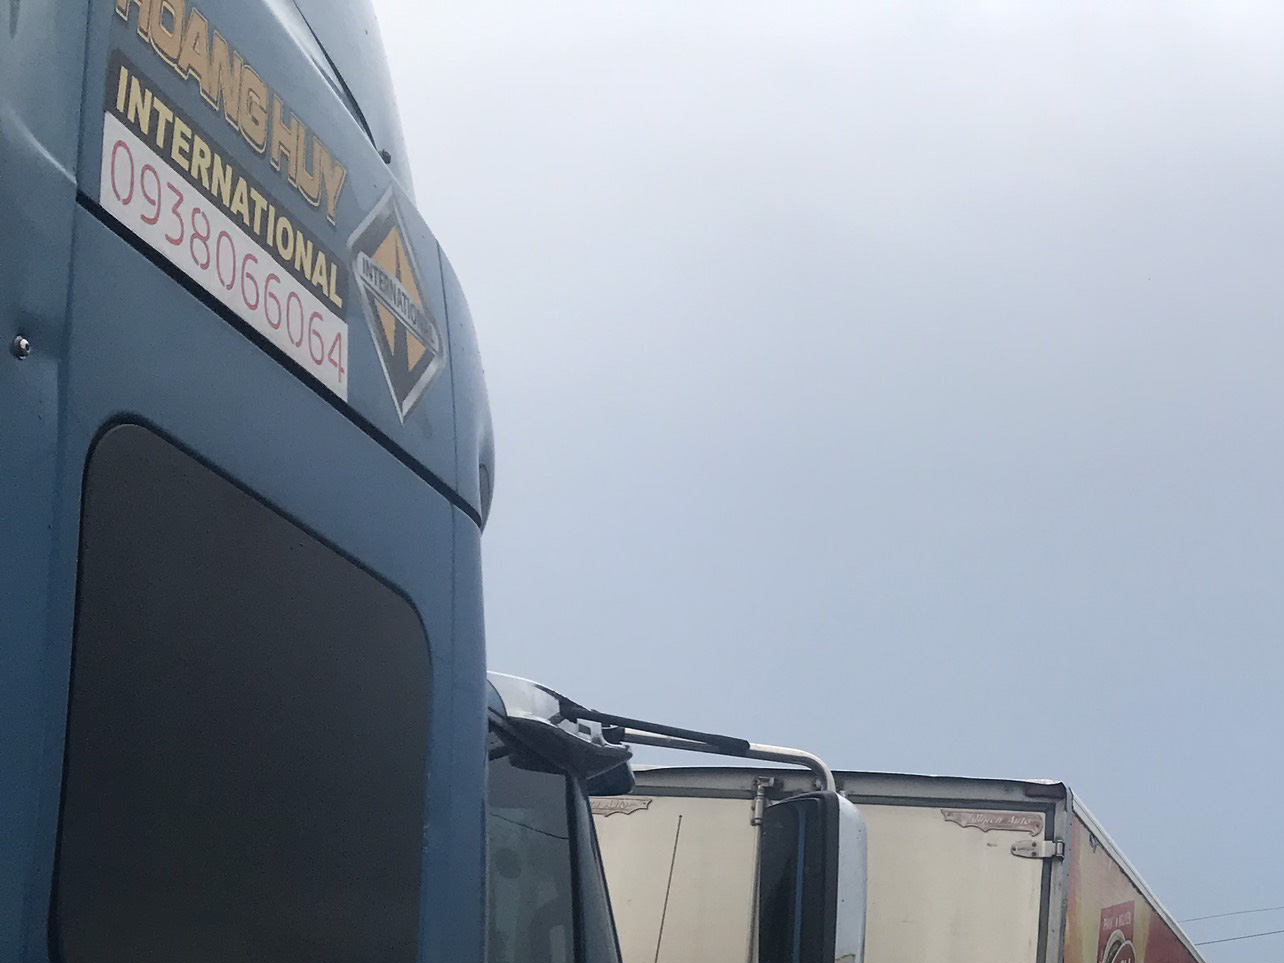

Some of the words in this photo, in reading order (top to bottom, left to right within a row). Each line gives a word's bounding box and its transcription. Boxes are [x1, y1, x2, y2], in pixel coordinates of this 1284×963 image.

[115, 66, 343, 308] INTERNATIONAL
[270, 91, 346, 226] HUY
[110, 140, 345, 383] 0938066064
[362, 257, 436, 346] INTERNATIONAL
